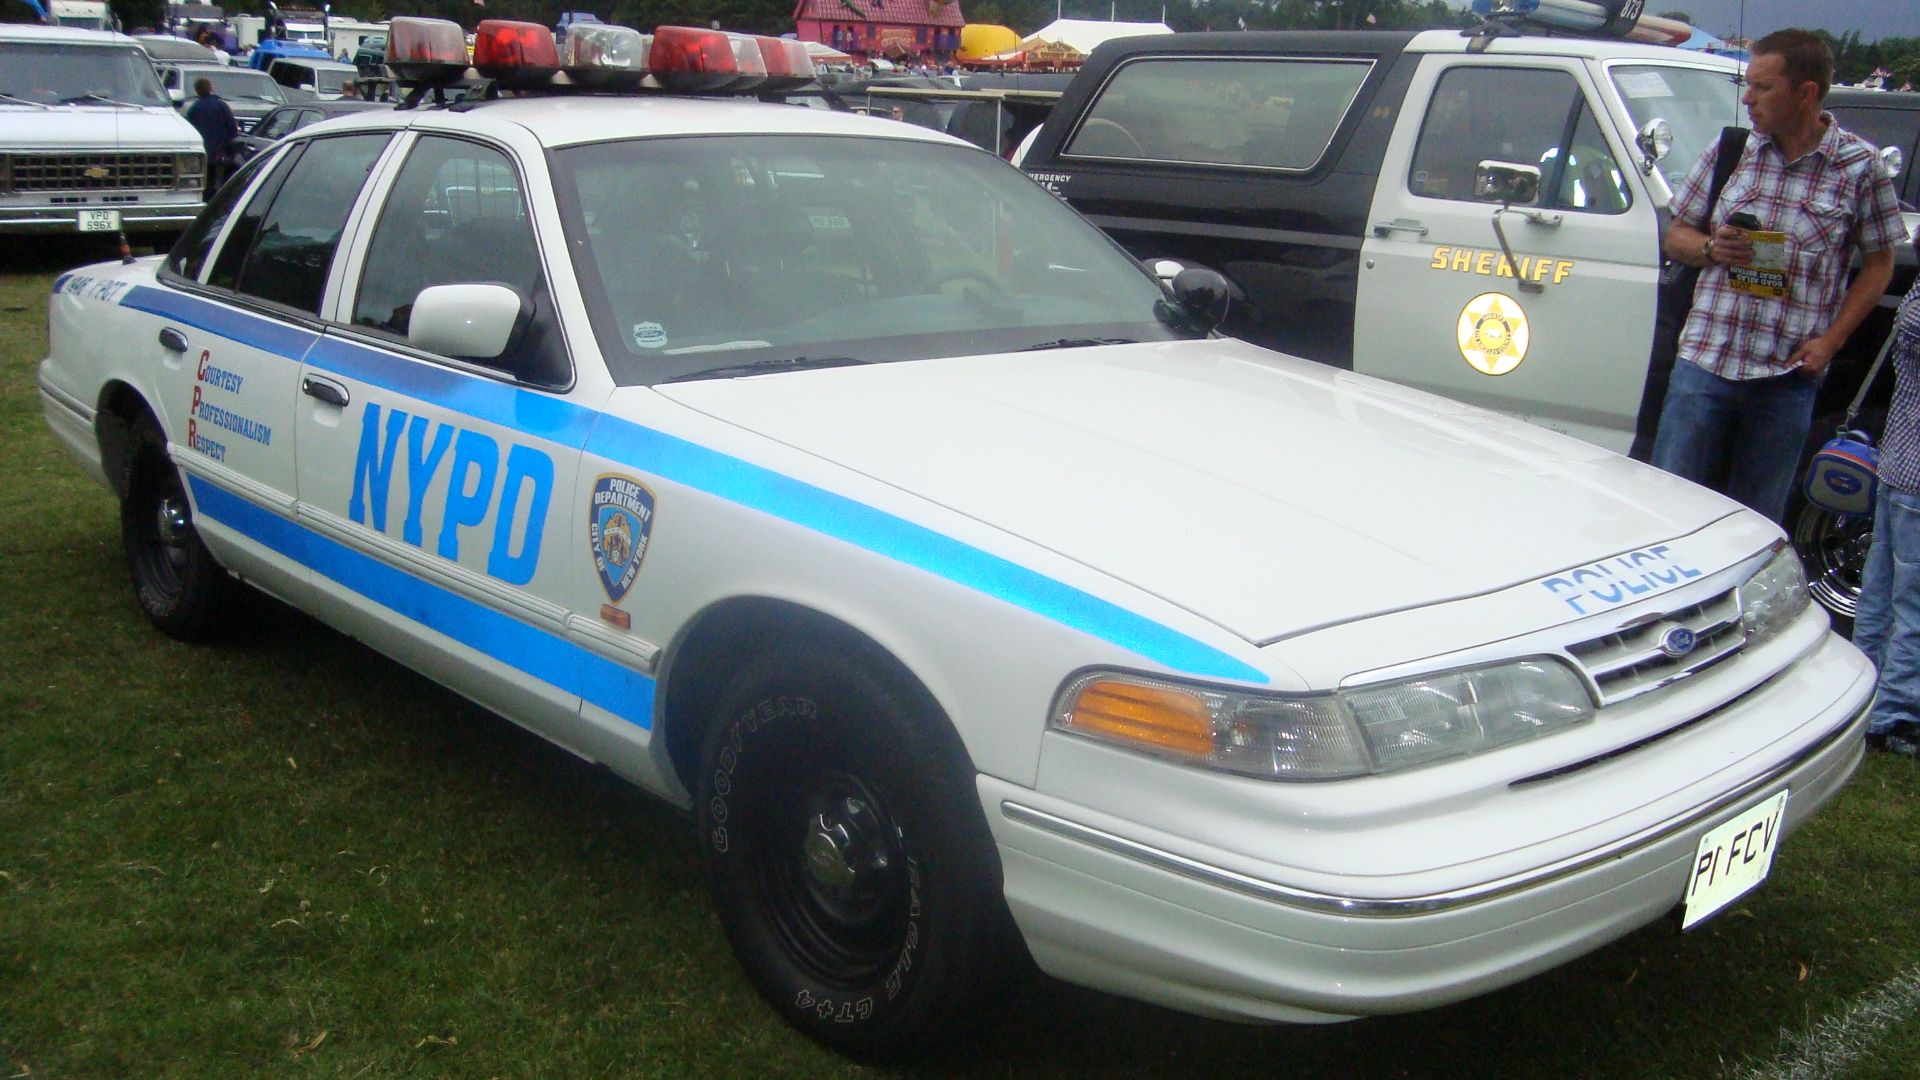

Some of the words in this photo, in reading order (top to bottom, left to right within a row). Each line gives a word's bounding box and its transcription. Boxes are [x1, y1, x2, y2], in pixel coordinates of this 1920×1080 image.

[1028, 173, 1071, 182] MERGENCY
[87, 221, 112, 230] 596X
[1431, 246, 1574, 284] SHERIFF
[1736, 273, 1759, 285] ATLAS
[1760, 278, 1783, 288] ROAD
[197, 349, 243, 394] COURTESY
[191, 385, 272, 446] PROFESSIONALISM
[188, 418, 226, 462] RESPECT
[348, 402, 555, 586] NYPD
[594, 491, 652, 522] DEPARTMENT
[609, 478, 641, 500] POLICE
[591, 522, 601, 552] CITY
[621, 563, 637, 590] NEW
[633, 534, 648, 566] YORK
[1541, 545, 1703, 615] POLICE
[711, 696, 817, 853] GOODYEAR
[1725, 811, 1779, 877] FCV
